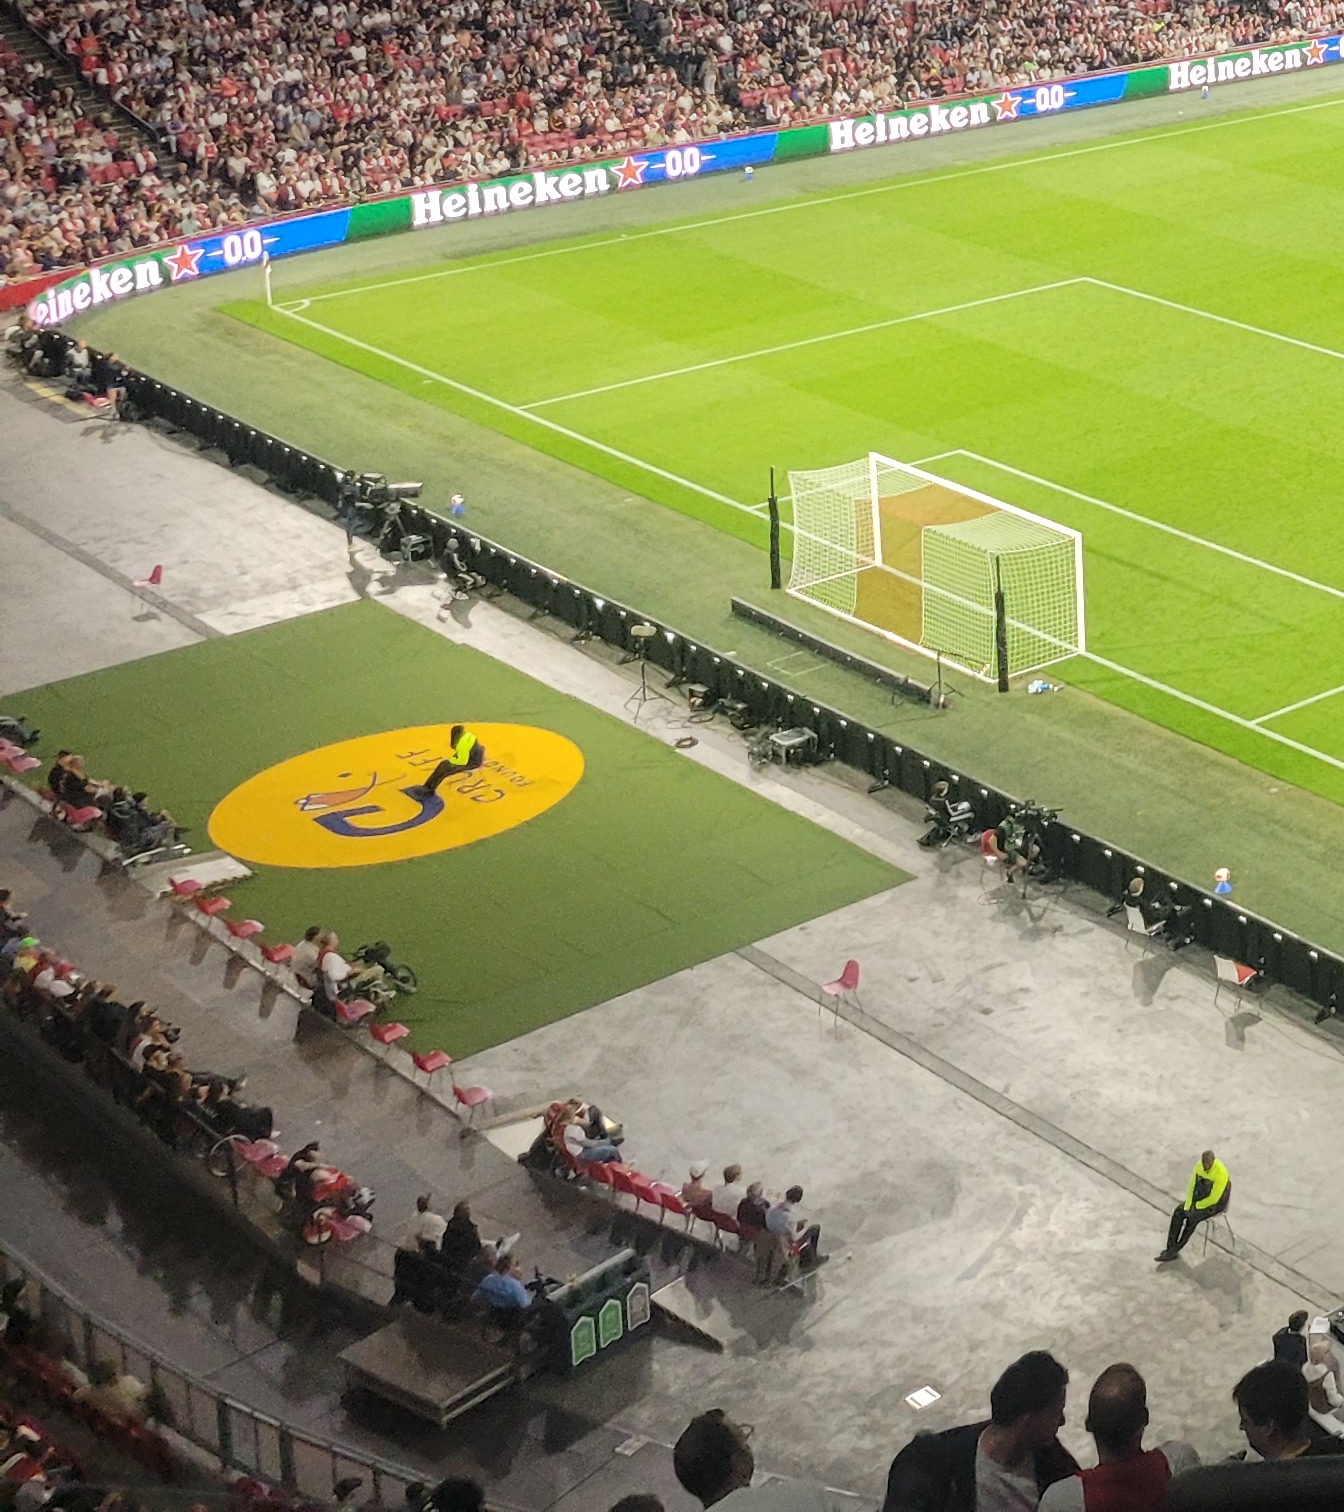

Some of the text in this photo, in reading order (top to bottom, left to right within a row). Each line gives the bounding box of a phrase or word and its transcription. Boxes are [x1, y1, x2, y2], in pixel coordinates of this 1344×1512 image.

[1167, 44, 1303, 90] Heineken
[827, 102, 991, 152] Heineken
[411, 164, 611, 227] Heineken
